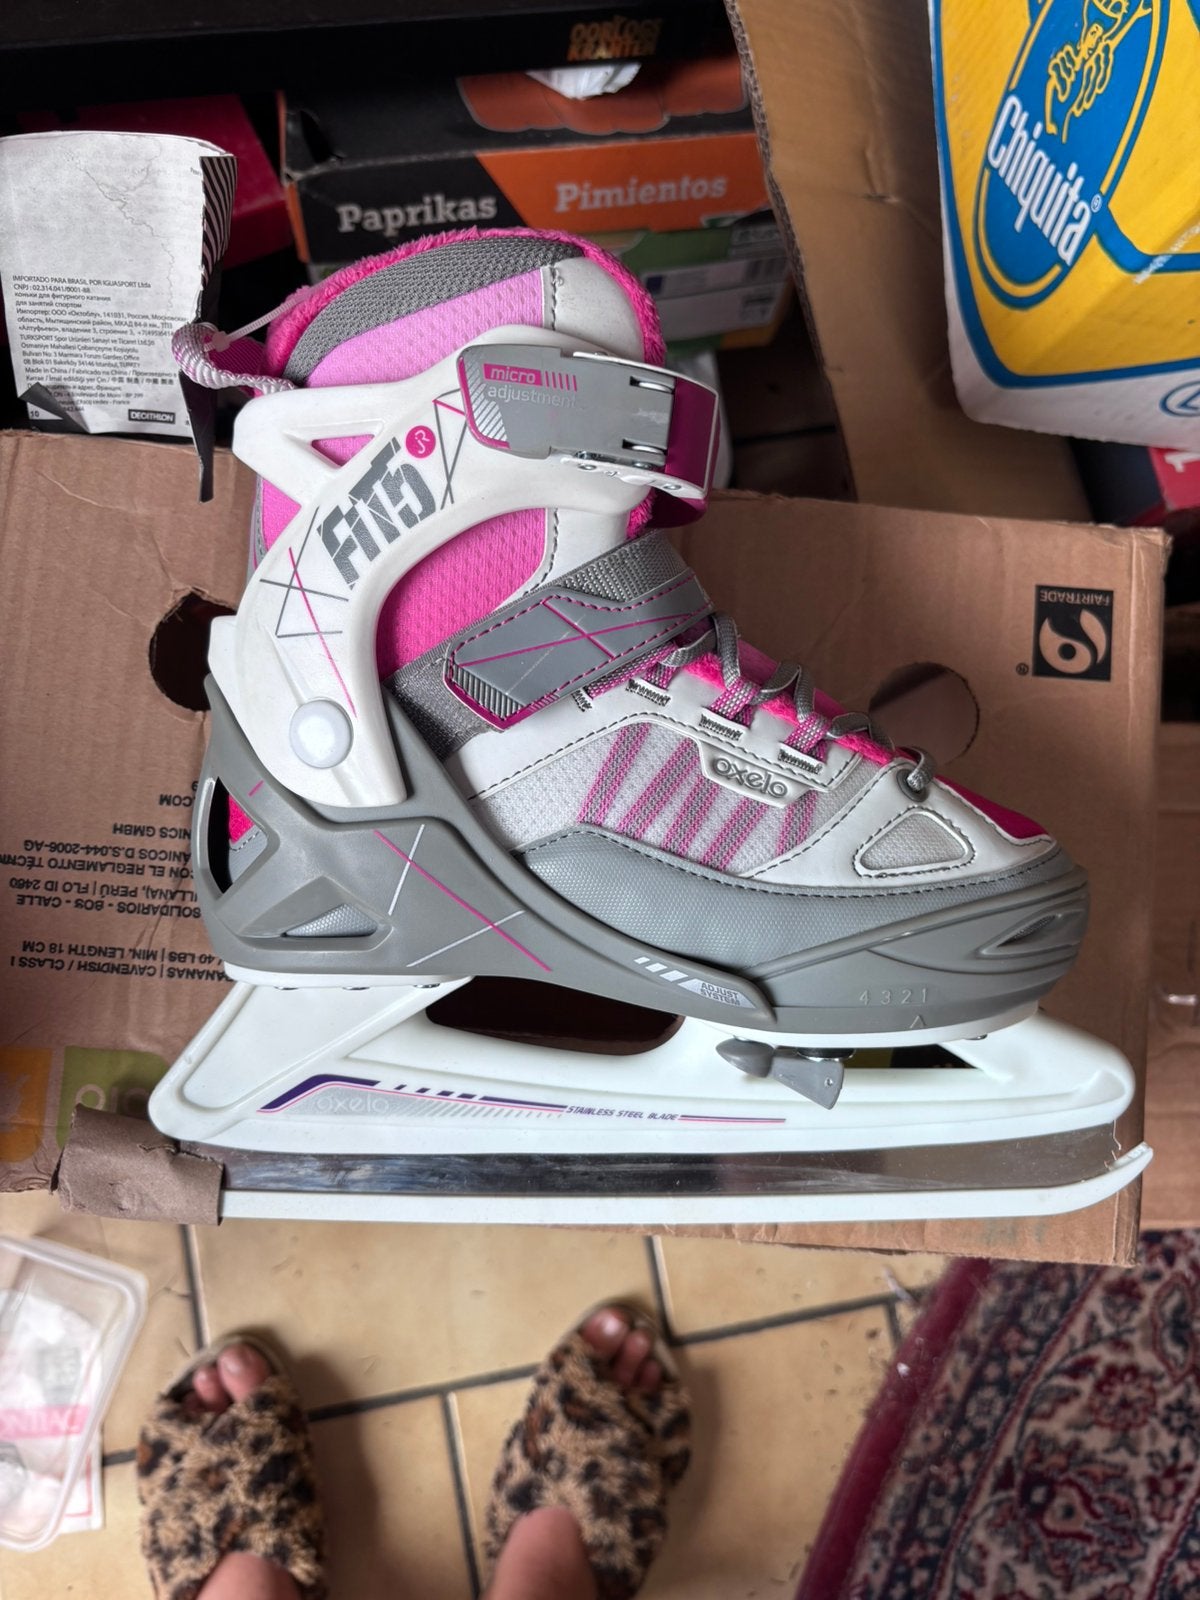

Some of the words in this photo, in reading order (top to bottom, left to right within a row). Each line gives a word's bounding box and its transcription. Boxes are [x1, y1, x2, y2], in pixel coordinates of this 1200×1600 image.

[986, 95, 1092, 267] Chiquita
[555, 176, 727, 213] Pimientos
[335, 194, 498, 239] Paprikas
[490, 366, 536, 384] micro
[488, 384, 577, 408] adjustment
[130, 411, 174, 422] DECATHLON
[1040, 589, 1110, 606] FAIRTRADE
[714, 758, 788, 798] oxelo
[112, 823, 155, 837] GMBH
[48, 857, 146, 875] REGLAMENTO
[148, 865, 165, 876] EL
[44, 880, 58, 891] ID
[62, 881, 89, 893] FLO
[100, 884, 137, 898] PERÚ
[16, 894, 61, 907] CALLE
[116, 901, 200, 918] SOLIDARIOS
[22, 940, 45, 952] CM
[49, 942, 64, 953] 18
[68, 944, 124, 958] LENGTH
[18, 956, 64, 970] CLASS
[168, 951, 195, 963] LBS
[76, 960, 156, 976] CAVENDISH
[702, 982, 738, 1000] ADJUST
[860, 990, 869, 1006] 4
[881, 990, 891, 1005] 3
[901, 988, 912, 1004] 2
[316, 1094, 389, 1113] oxelo
[566, 1105, 614, 1116] STAINLESS
[616, 1110, 644, 1118] STEEL
[647, 1112, 678, 1121] BLADE
